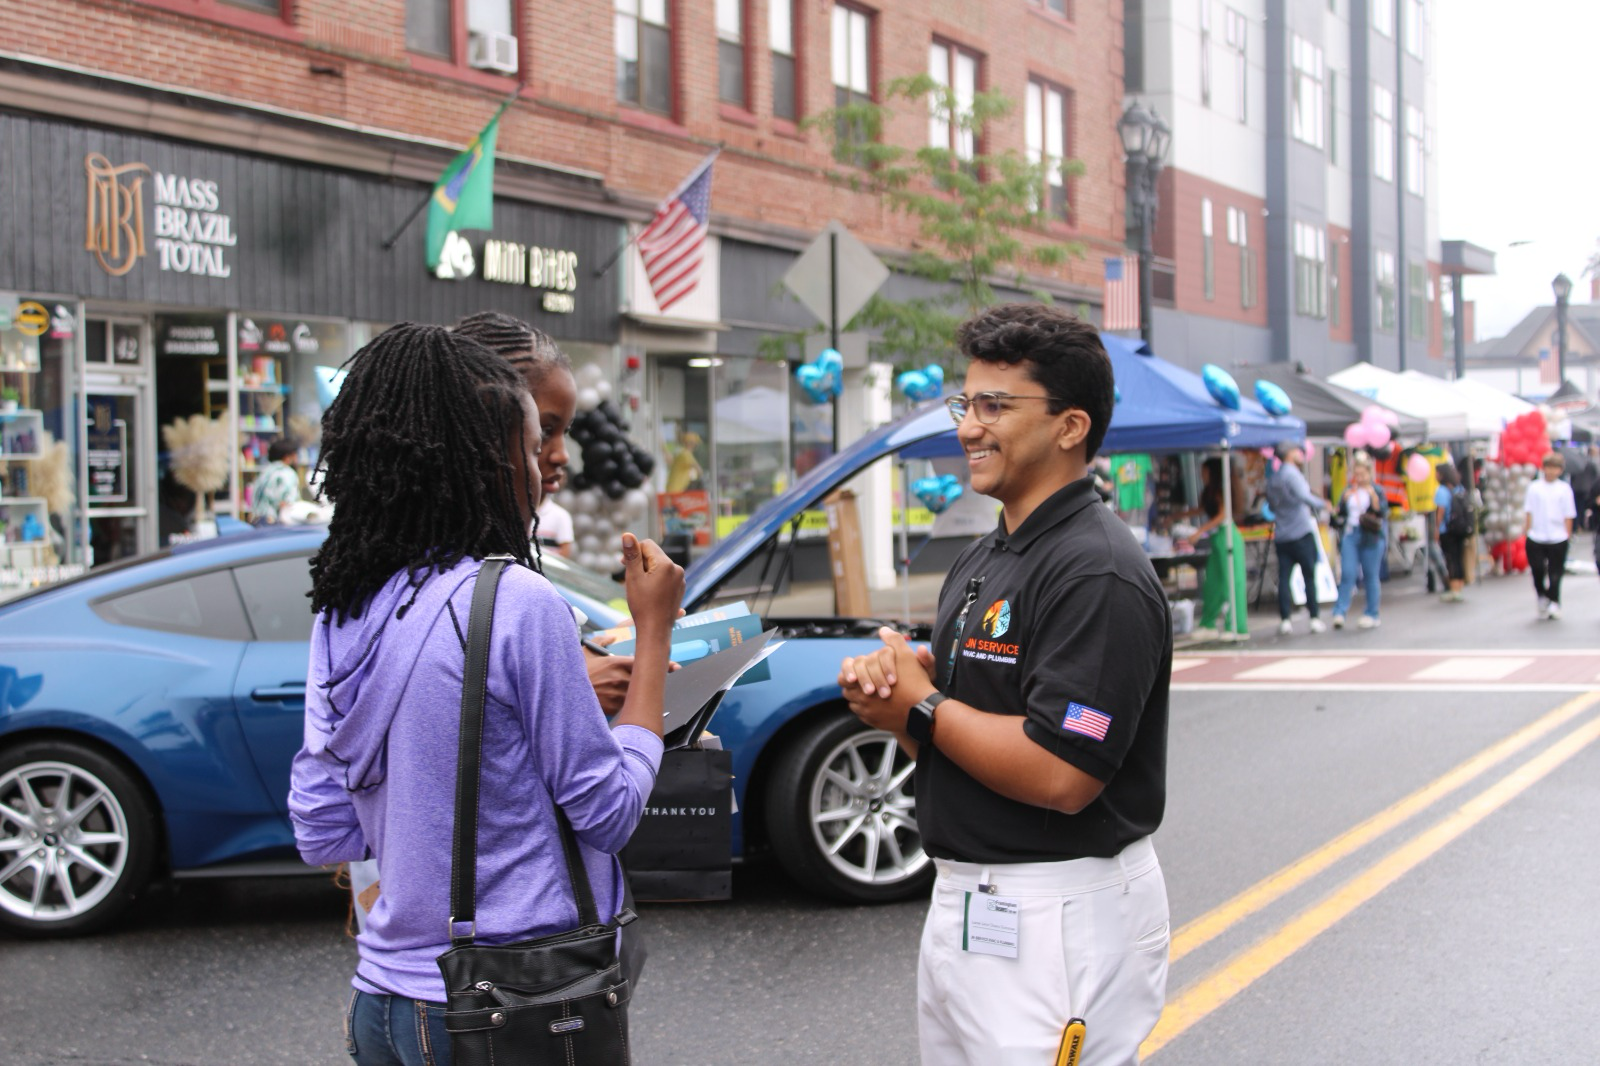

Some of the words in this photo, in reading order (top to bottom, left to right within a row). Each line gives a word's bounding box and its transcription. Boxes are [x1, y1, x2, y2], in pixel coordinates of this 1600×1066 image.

[155, 171, 219, 212] MASS
[155, 204, 237, 247] BRAZIL
[156, 239, 231, 278] TOTAL
[965, 638, 977, 649] JN
[978, 640, 1019, 655] SERVICE
[976, 652, 987, 660] AND
[987, 654, 1017, 664] PLUMBING
[643, 807, 686, 816] THANK
[690, 807, 716, 816] YOU
